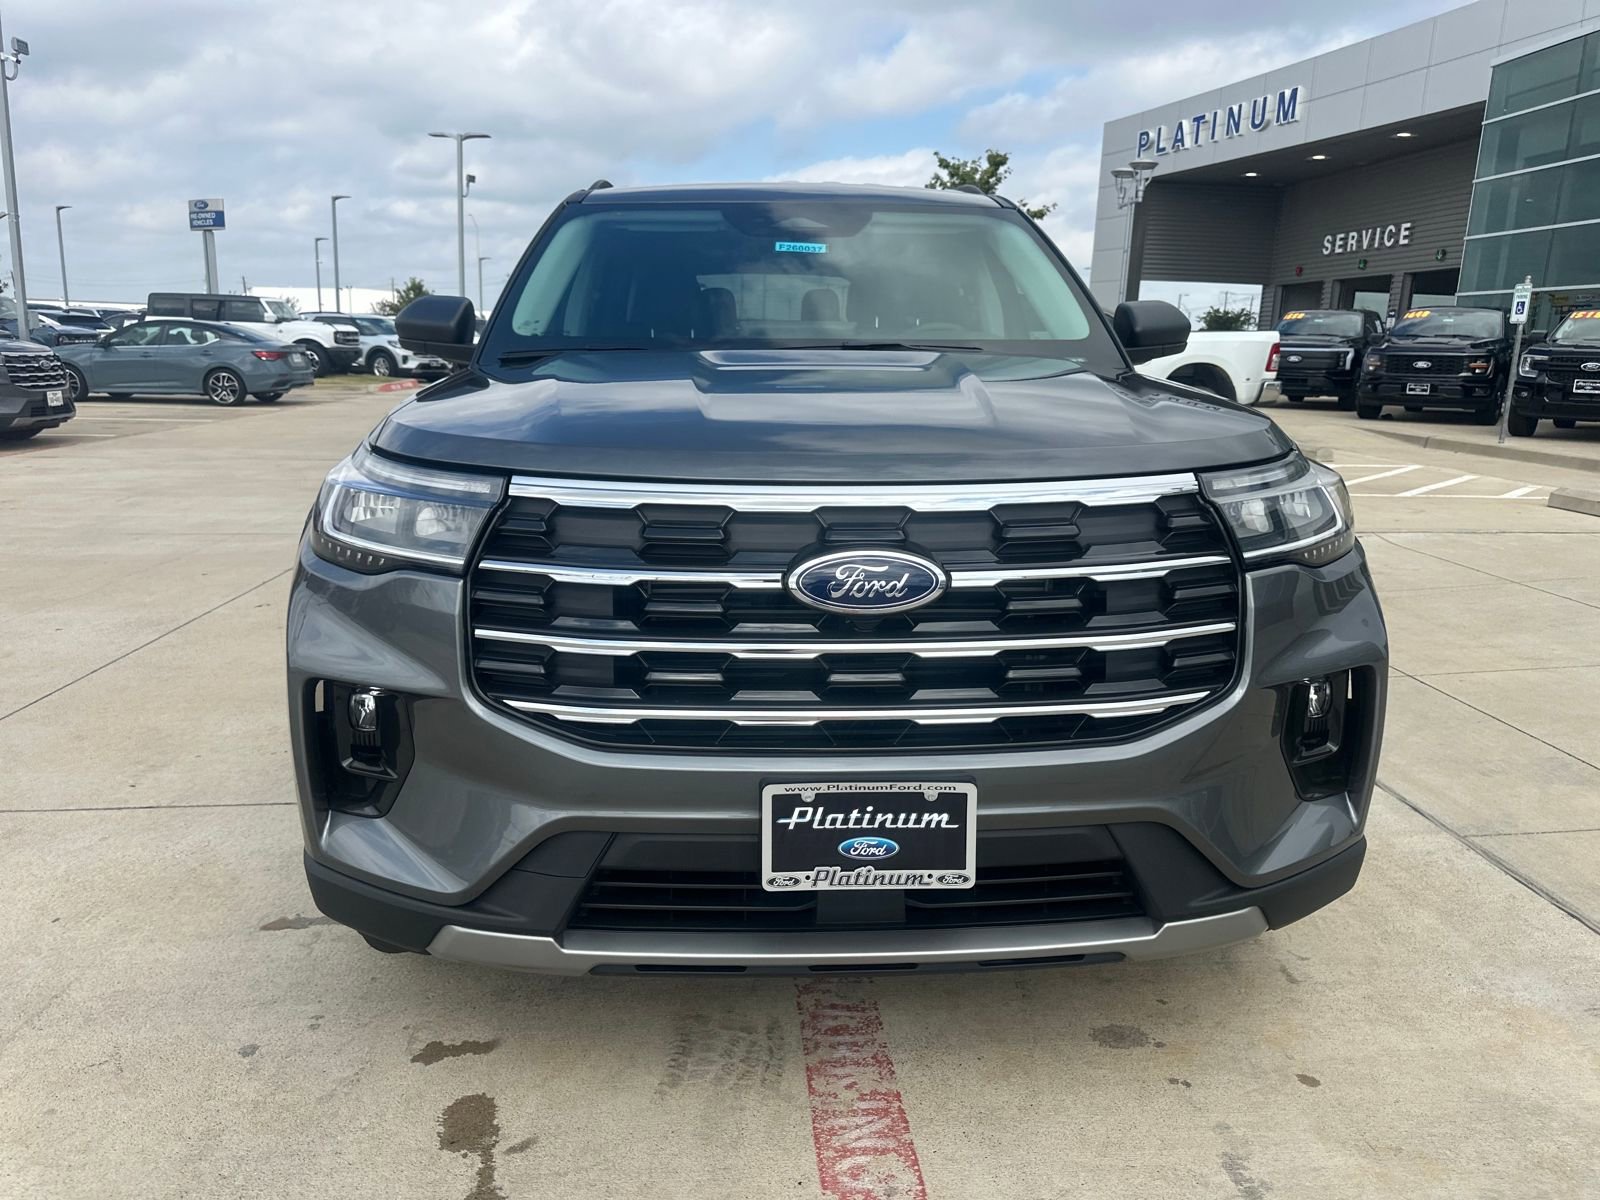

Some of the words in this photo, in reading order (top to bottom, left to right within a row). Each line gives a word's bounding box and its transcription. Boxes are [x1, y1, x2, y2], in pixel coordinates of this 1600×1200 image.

[1136, 85, 1303, 160] PLATINUM
[778, 243, 823, 252] F260037
[1322, 222, 1412, 255] SERVICE
[827, 563, 909, 599] Ford
[784, 784, 957, 792] www.PlatinumFord.com
[776, 805, 960, 830] Platinum
[850, 839, 887, 856] Ford
[773, 876, 796, 887] Ford
[811, 866, 934, 888] Platinum
[942, 875, 964, 885] Ford
